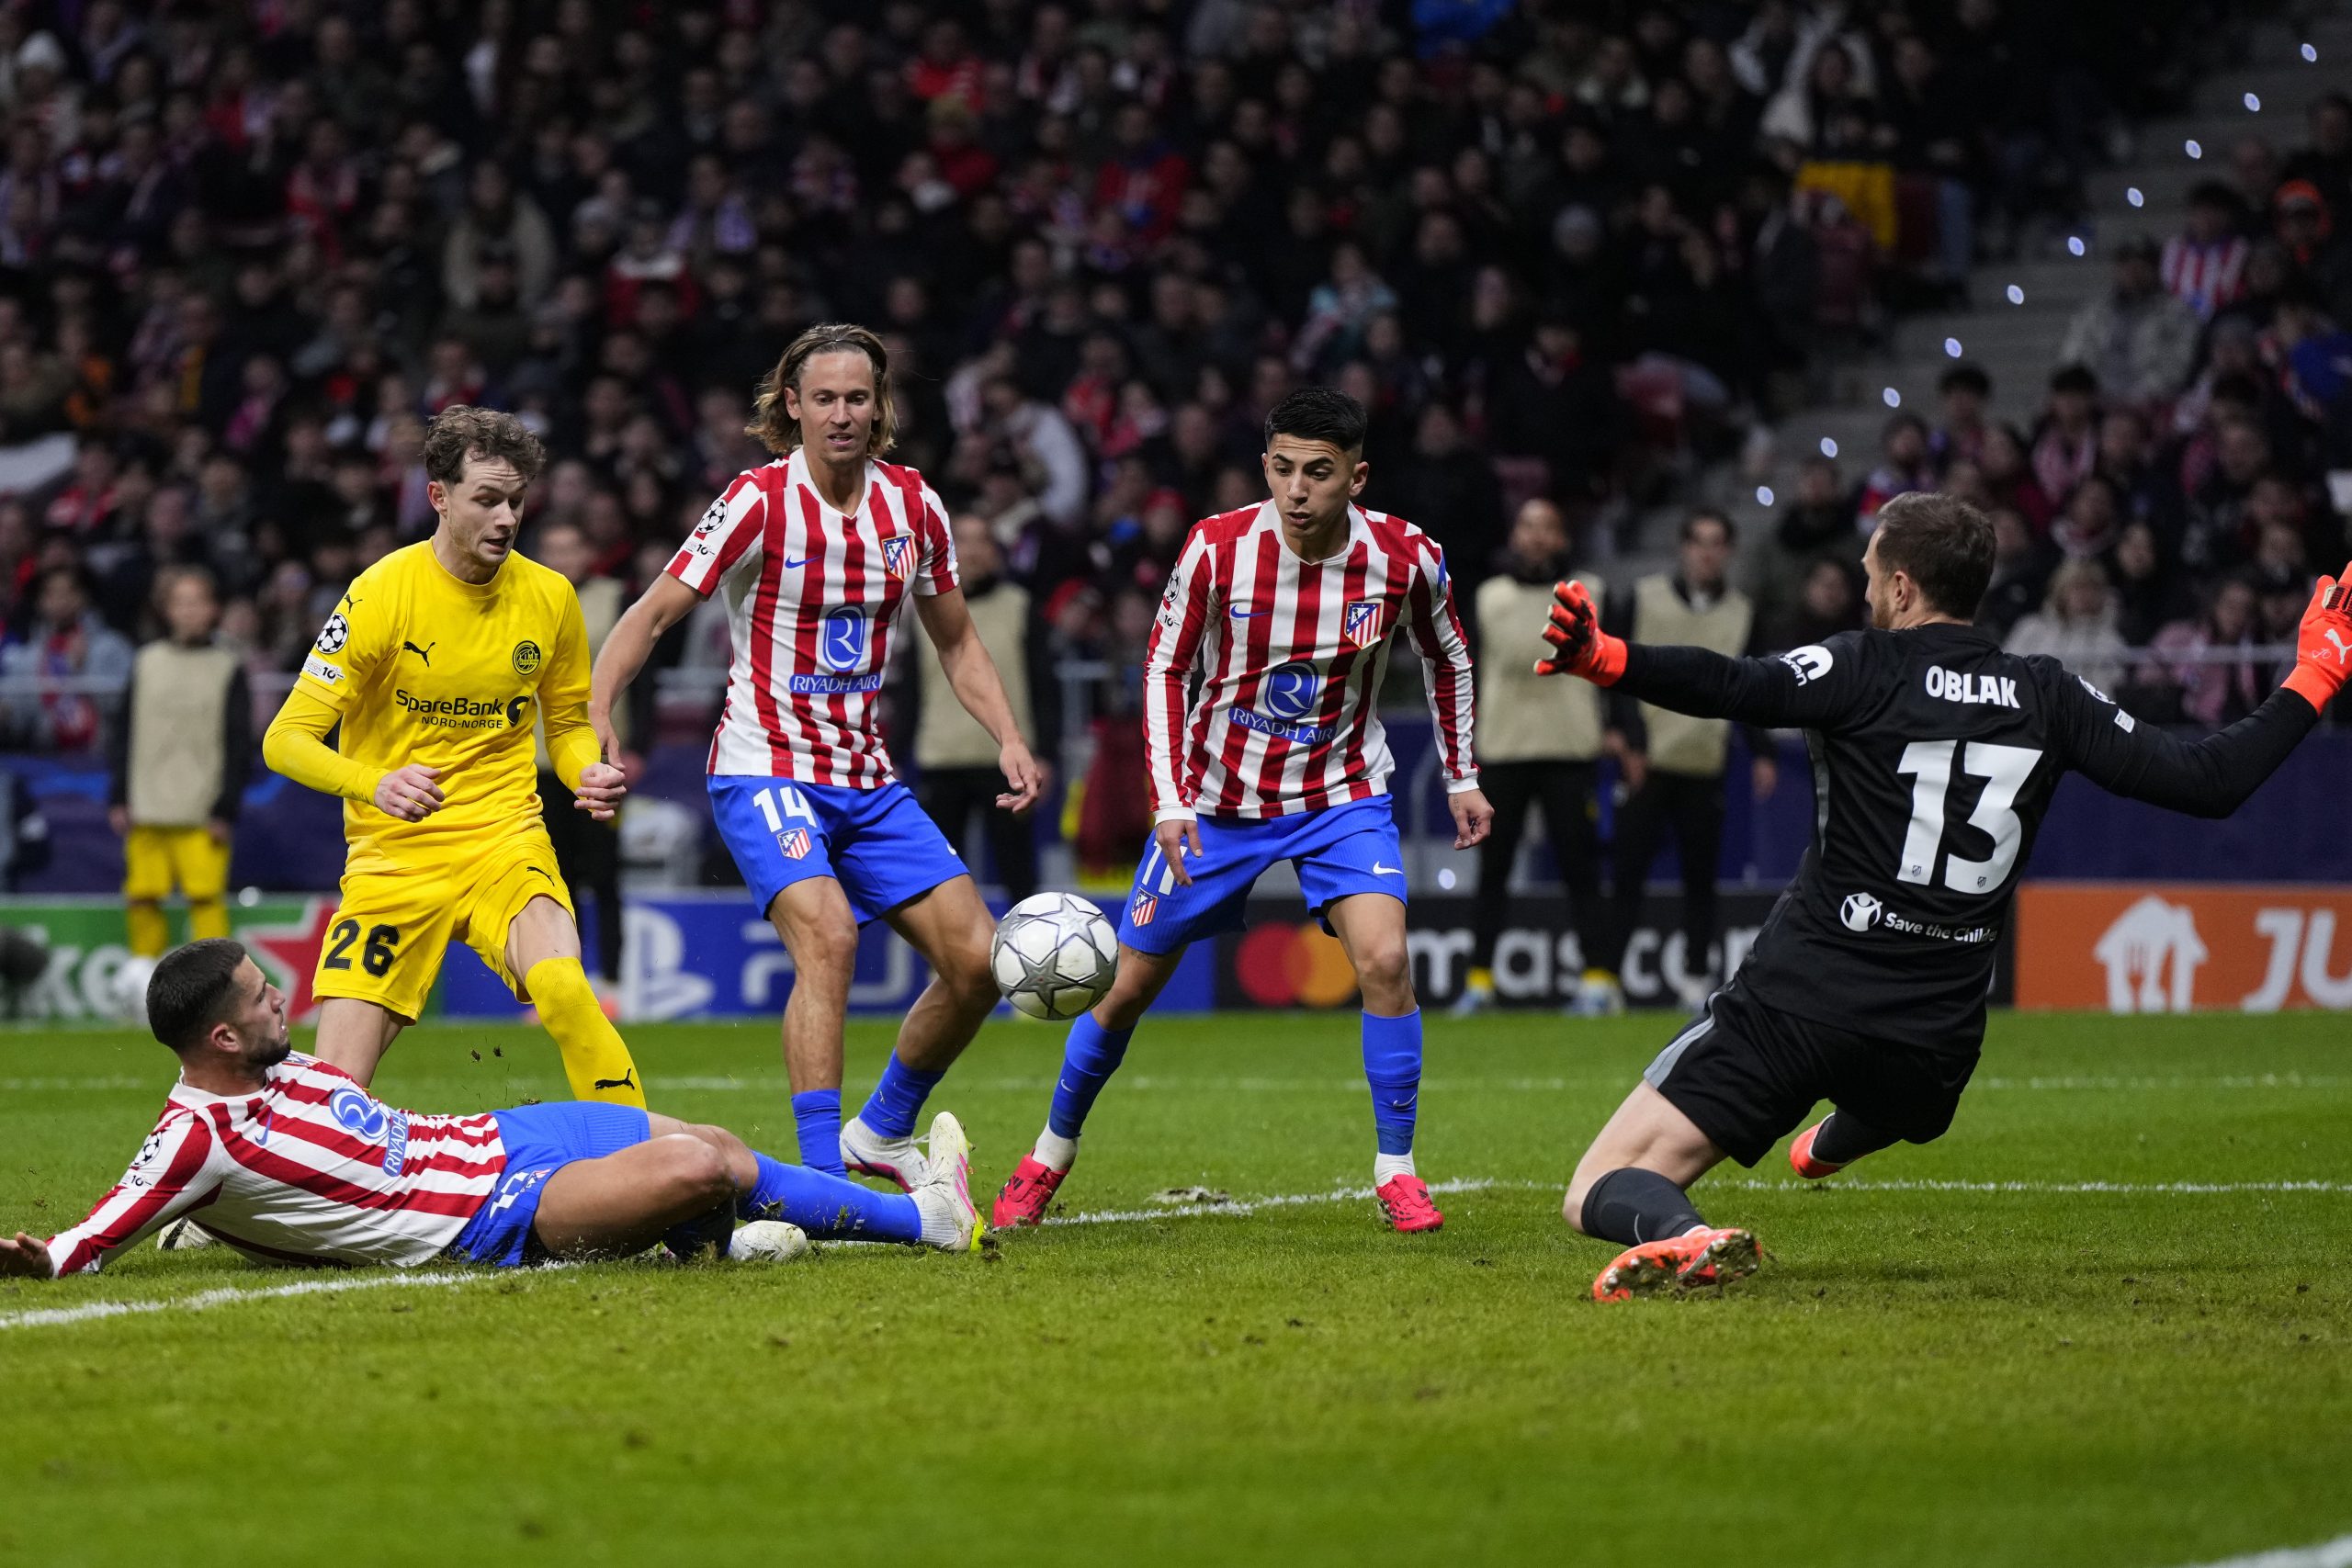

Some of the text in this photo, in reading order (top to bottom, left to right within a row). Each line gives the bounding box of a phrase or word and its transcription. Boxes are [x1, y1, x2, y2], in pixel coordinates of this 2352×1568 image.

[395, 688, 505, 716] SpareBank
[793, 674, 878, 692] RIYADH AIR
[1925, 664, 2021, 709] OBLAK
[421, 716, 503, 729] NORD-NORGE
[1232, 707, 1333, 743] RIYADH AIR
[752, 786, 818, 833] 14
[1895, 739, 2044, 896] 13
[1883, 911, 1924, 934] Save
[1925, 923, 1951, 940] the
[322, 919, 401, 979] 26
[384, 1111, 407, 1174] RIYADH
